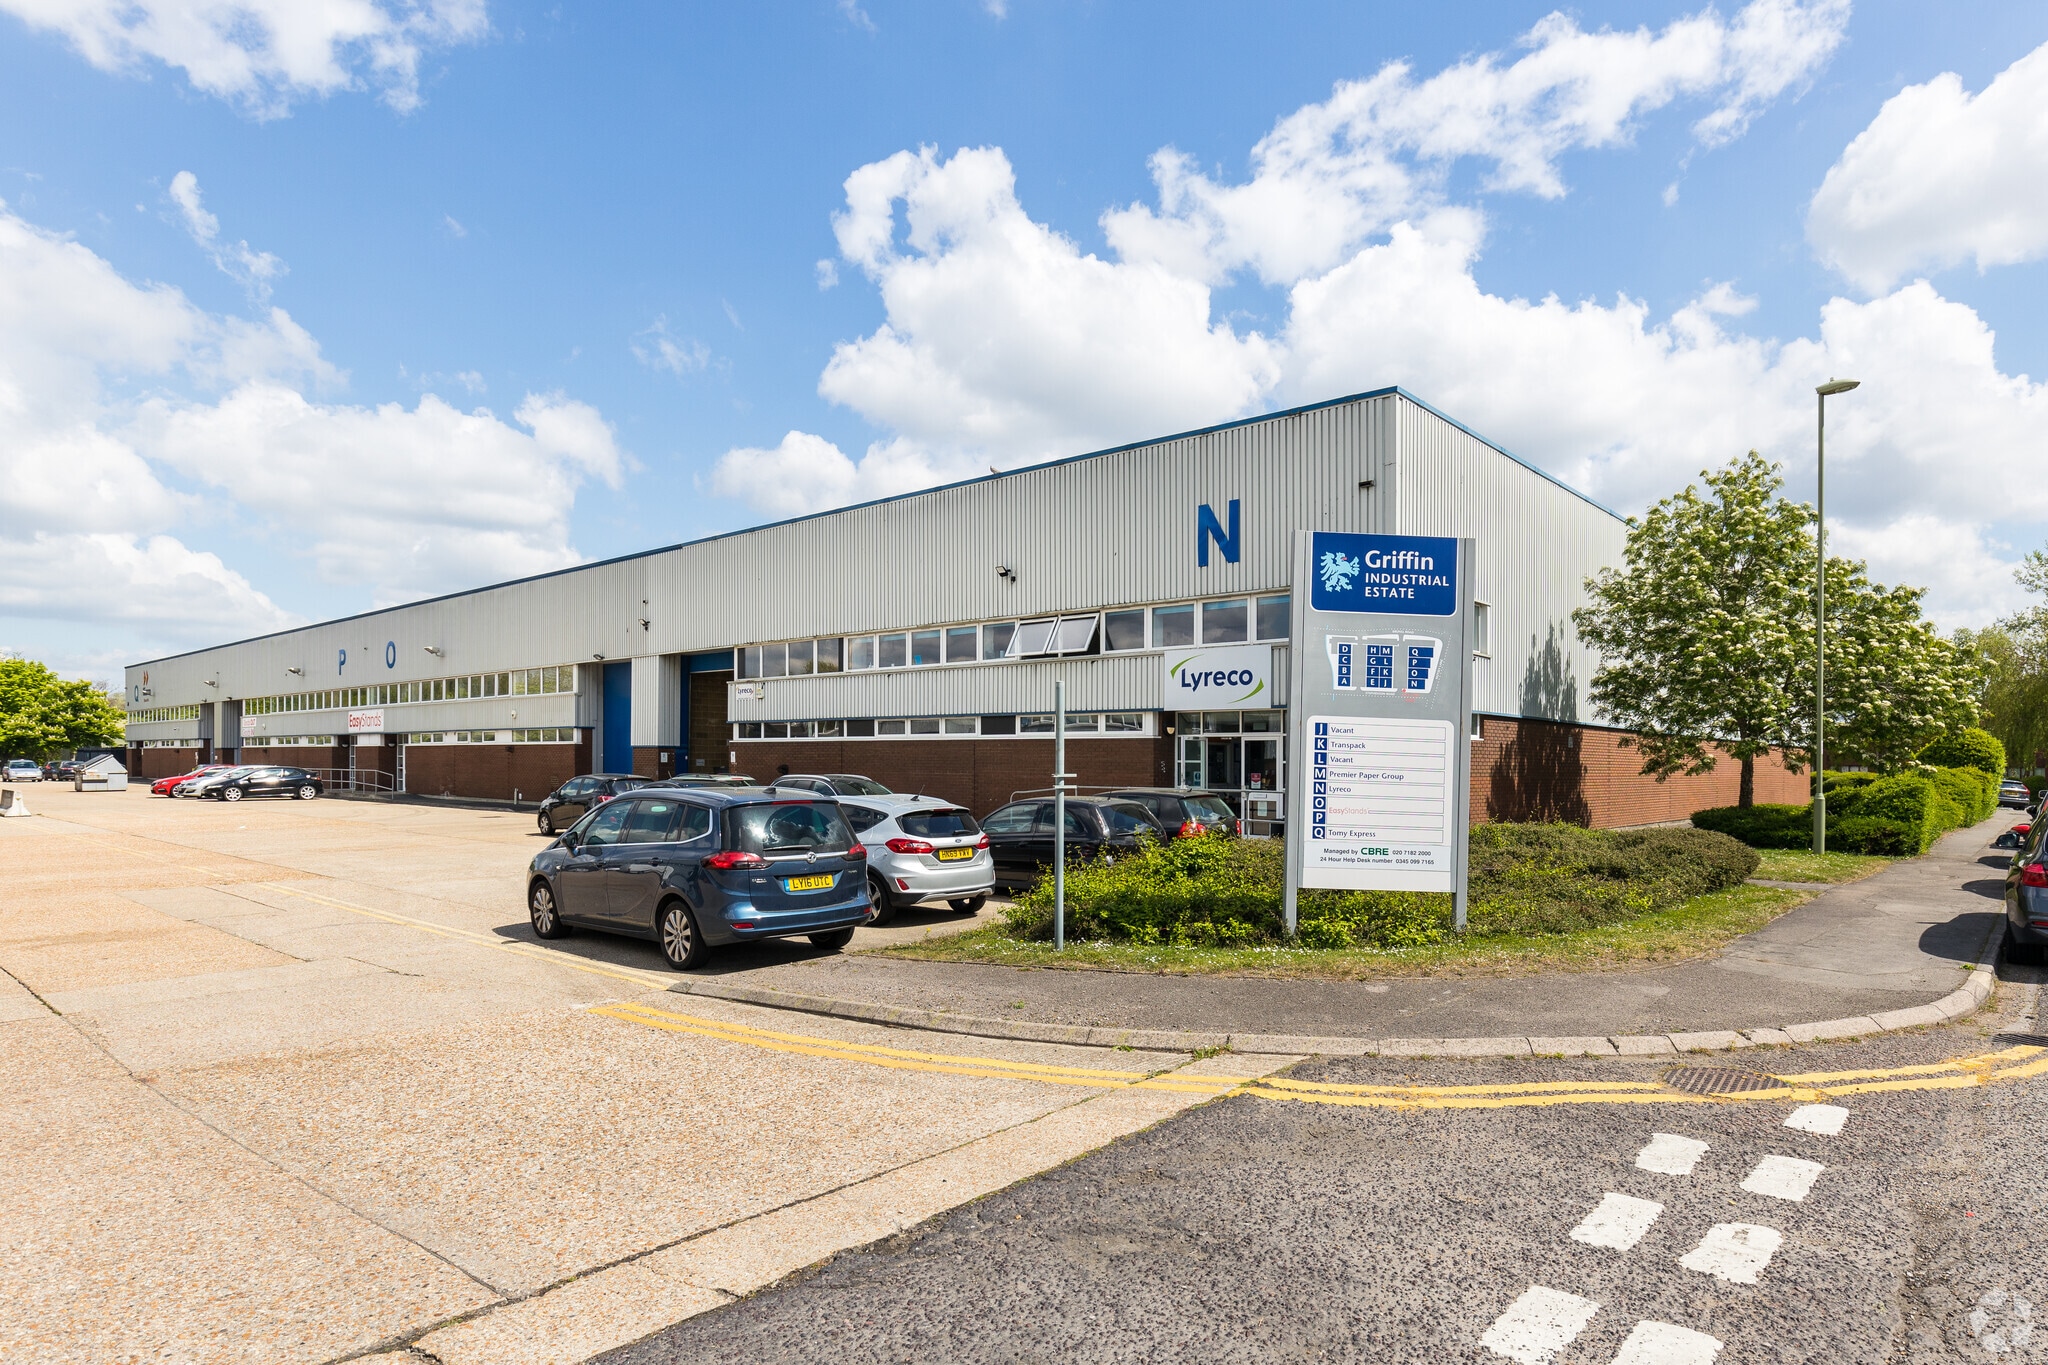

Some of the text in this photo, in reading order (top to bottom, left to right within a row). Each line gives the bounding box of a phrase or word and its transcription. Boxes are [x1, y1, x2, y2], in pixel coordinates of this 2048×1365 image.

[1198, 499, 1240, 567] N
[1365, 550, 1434, 570] Griffin
[1365, 572, 1449, 587] INDUSTRIAL
[1365, 586, 1415, 599] ESTATE
[386, 641, 396, 669] O
[1411, 649, 1419, 657] Q
[339, 649, 346, 675] P
[1181, 668, 1254, 692] Lyreco
[349, 711, 381, 730] EasyStands
[1319, 723, 1323, 735] J
[1317, 739, 1366, 750] K Transpack
[1318, 753, 1324, 764] L
[1314, 768, 1326, 778] M
[1359, 772, 1379, 780] Paper
[1381, 773, 1404, 781] Group
[1315, 783, 1325, 793] N
[1315, 798, 1324, 808] O
[1329, 807, 1368, 815] EasyStands
[1316, 813, 1323, 823] P
[1314, 827, 1376, 839] Q Tomy Express
[1360, 847, 1389, 856] CBRE
[793, 876, 830, 889] LY16 UTC
